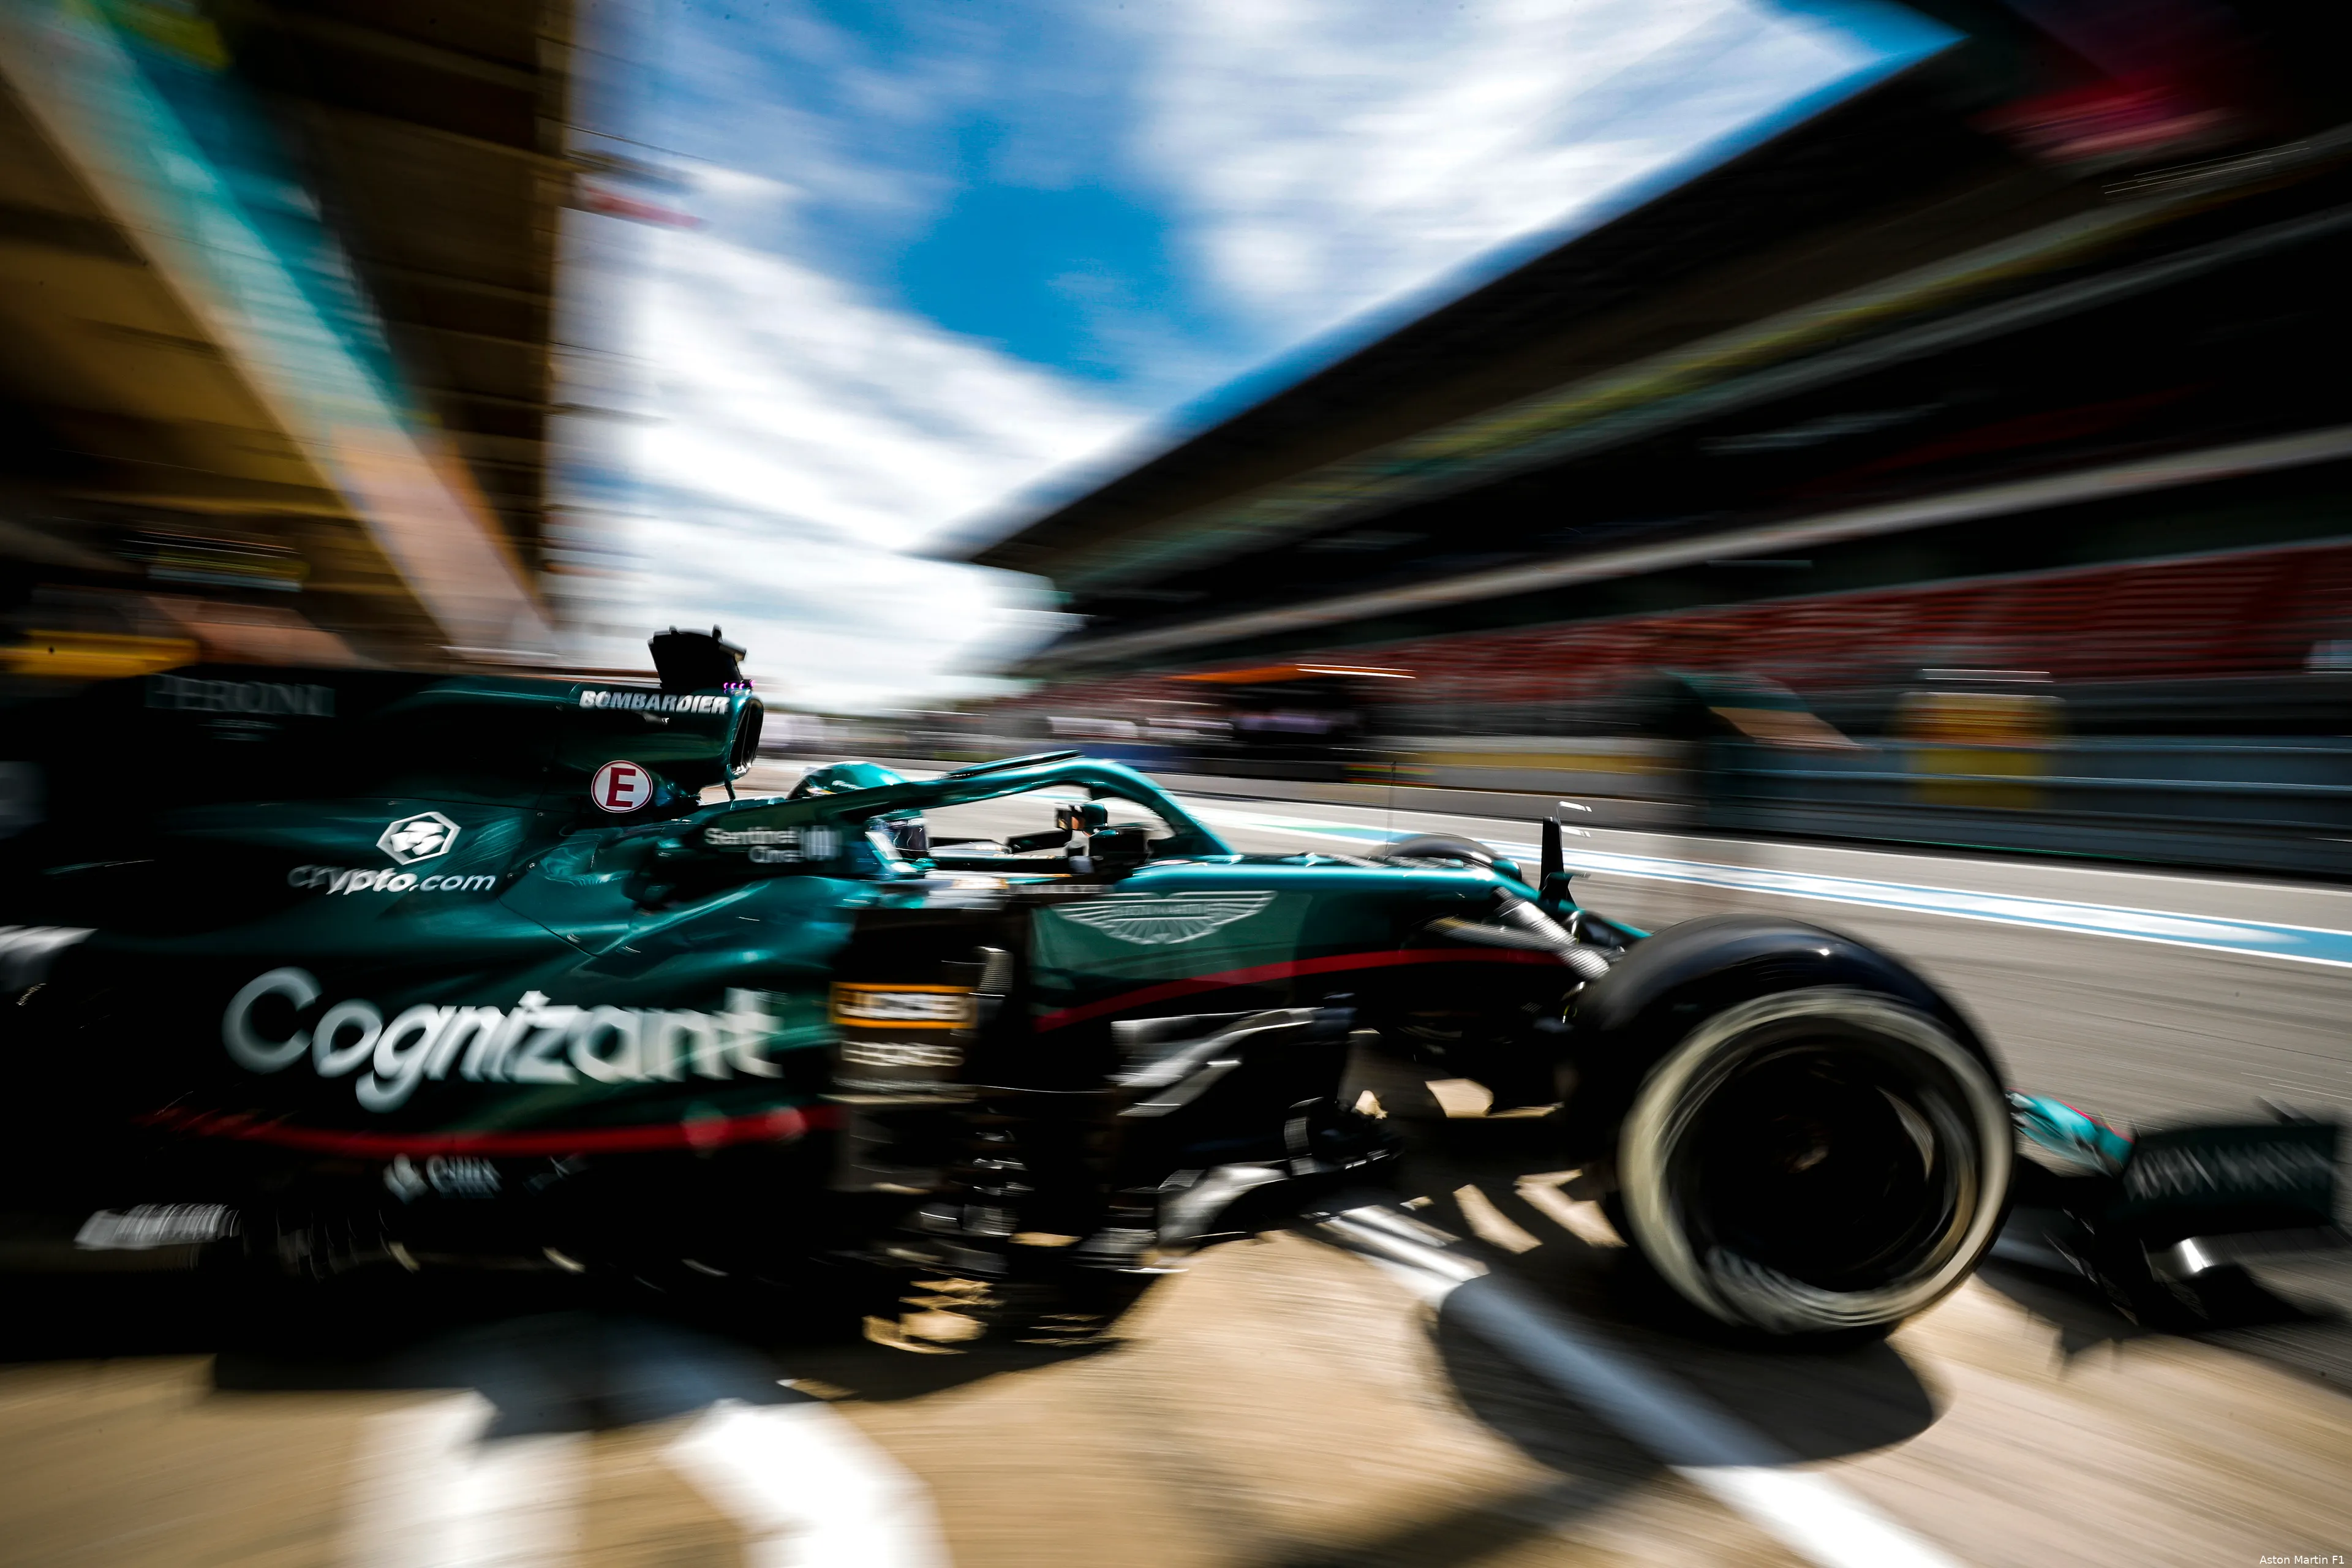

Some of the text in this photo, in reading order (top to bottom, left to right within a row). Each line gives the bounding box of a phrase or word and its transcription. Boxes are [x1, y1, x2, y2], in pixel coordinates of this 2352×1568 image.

[579, 690, 731, 715] BOMBARDIER
[606, 767, 636, 807] E
[287, 864, 496, 895] crypto.com
[222, 967, 784, 1113] Cognizant
